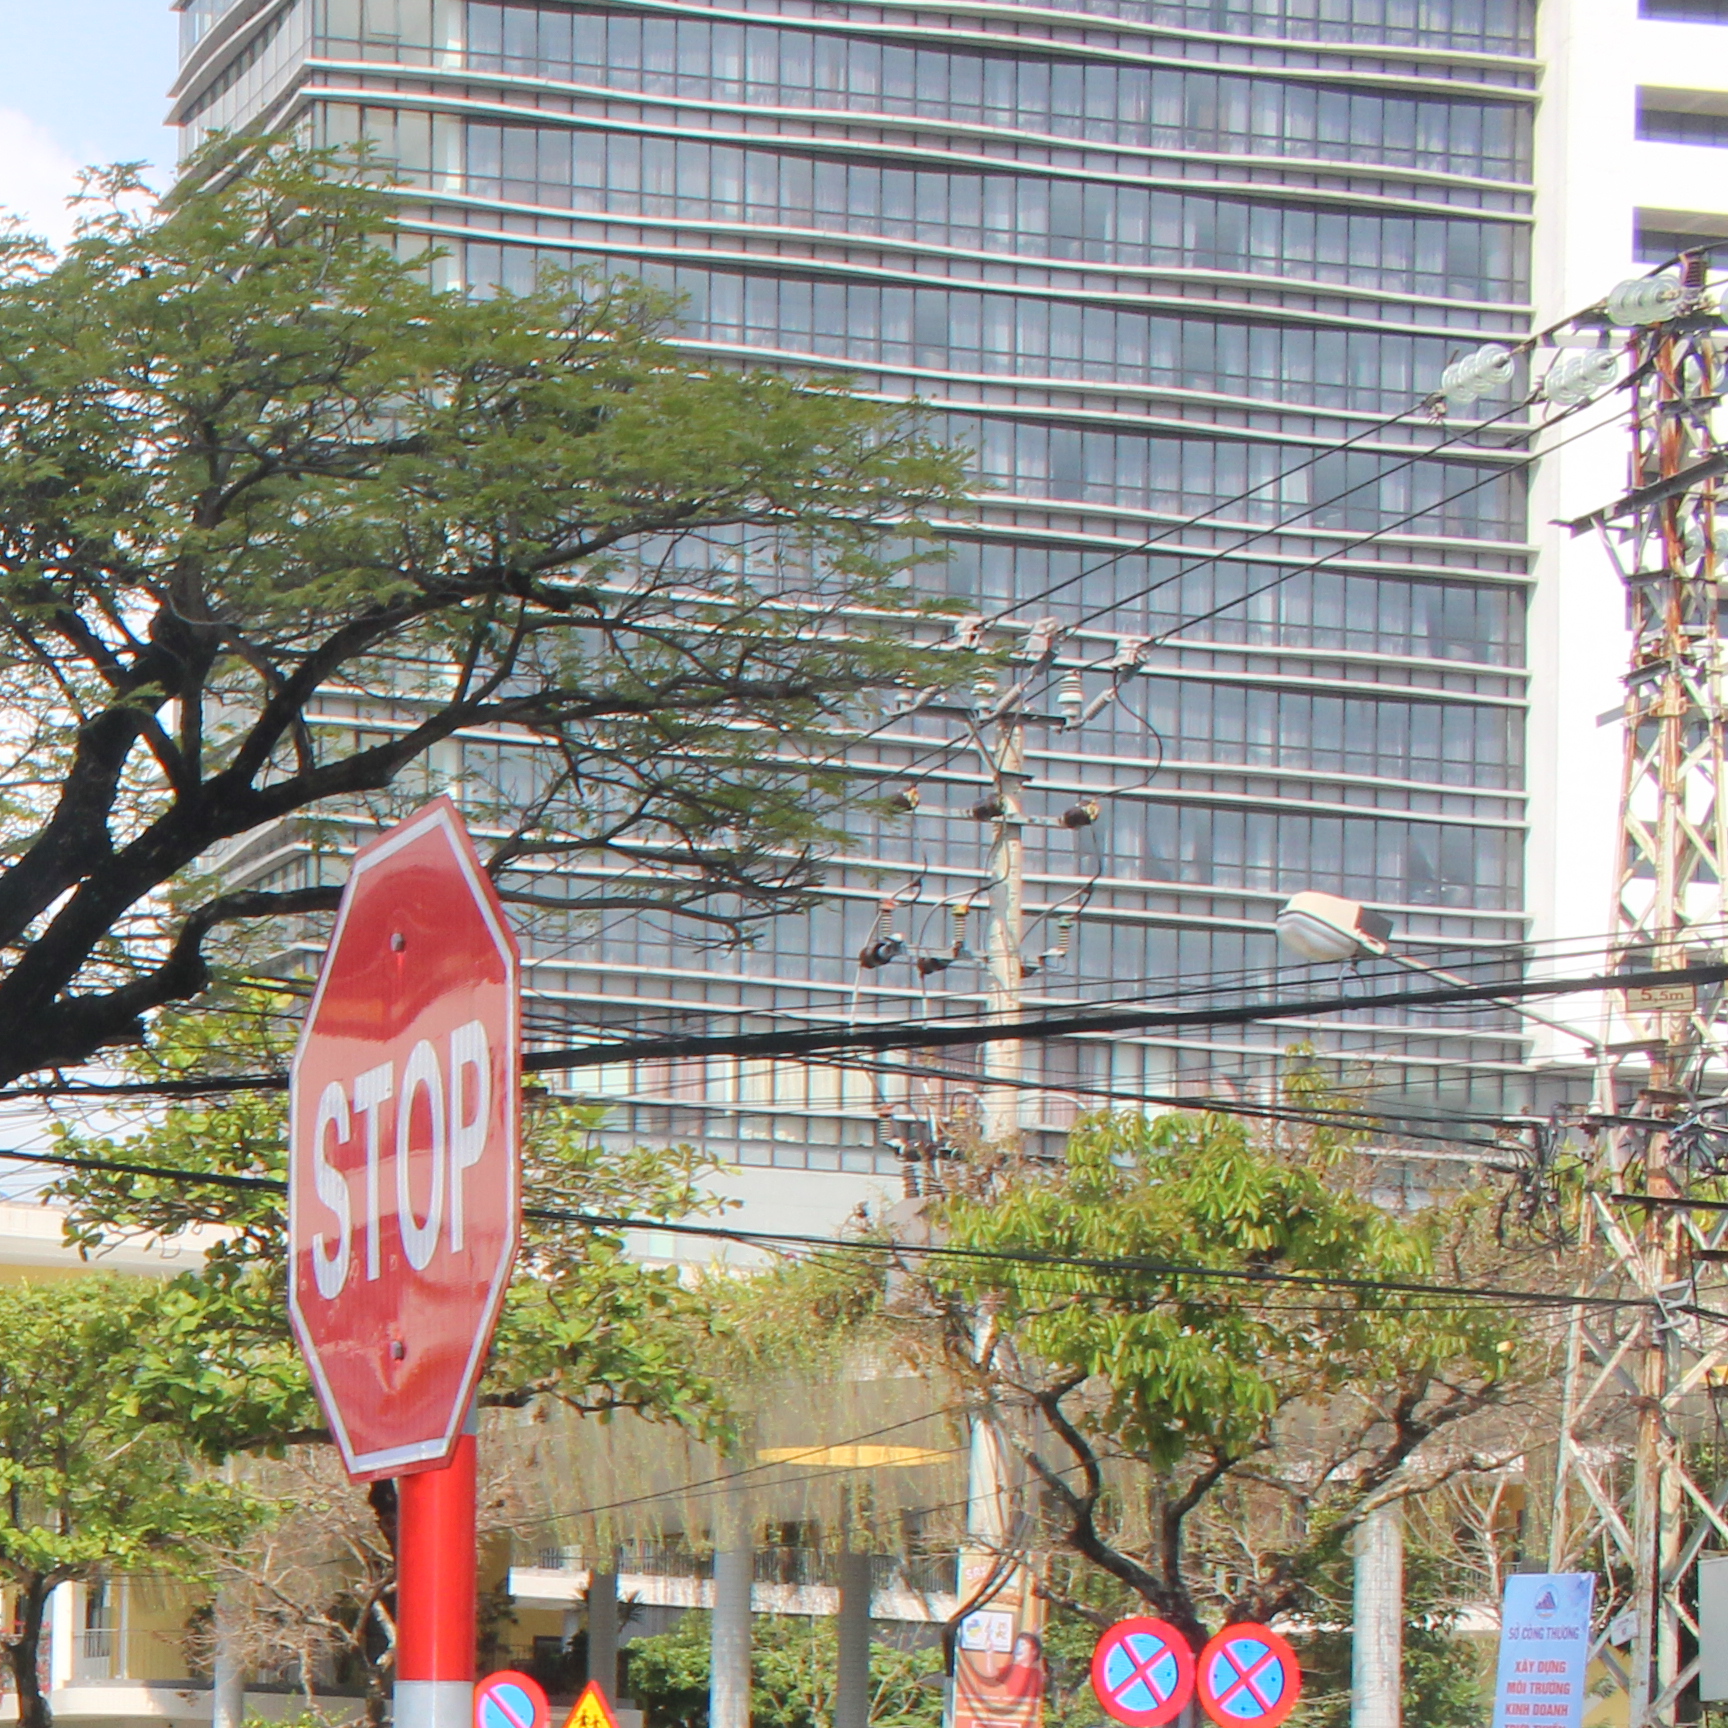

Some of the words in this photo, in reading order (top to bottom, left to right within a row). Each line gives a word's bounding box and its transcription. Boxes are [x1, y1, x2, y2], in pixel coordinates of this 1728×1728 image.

[312, 1019, 491, 1300] STOP
[1515, 1658, 1535, 1673] XÂY
[1537, 1660, 1566, 1675] DỰNG
[1505, 1703, 1530, 1716] KINH
[1532, 1704, 1568, 1716] DOANH
